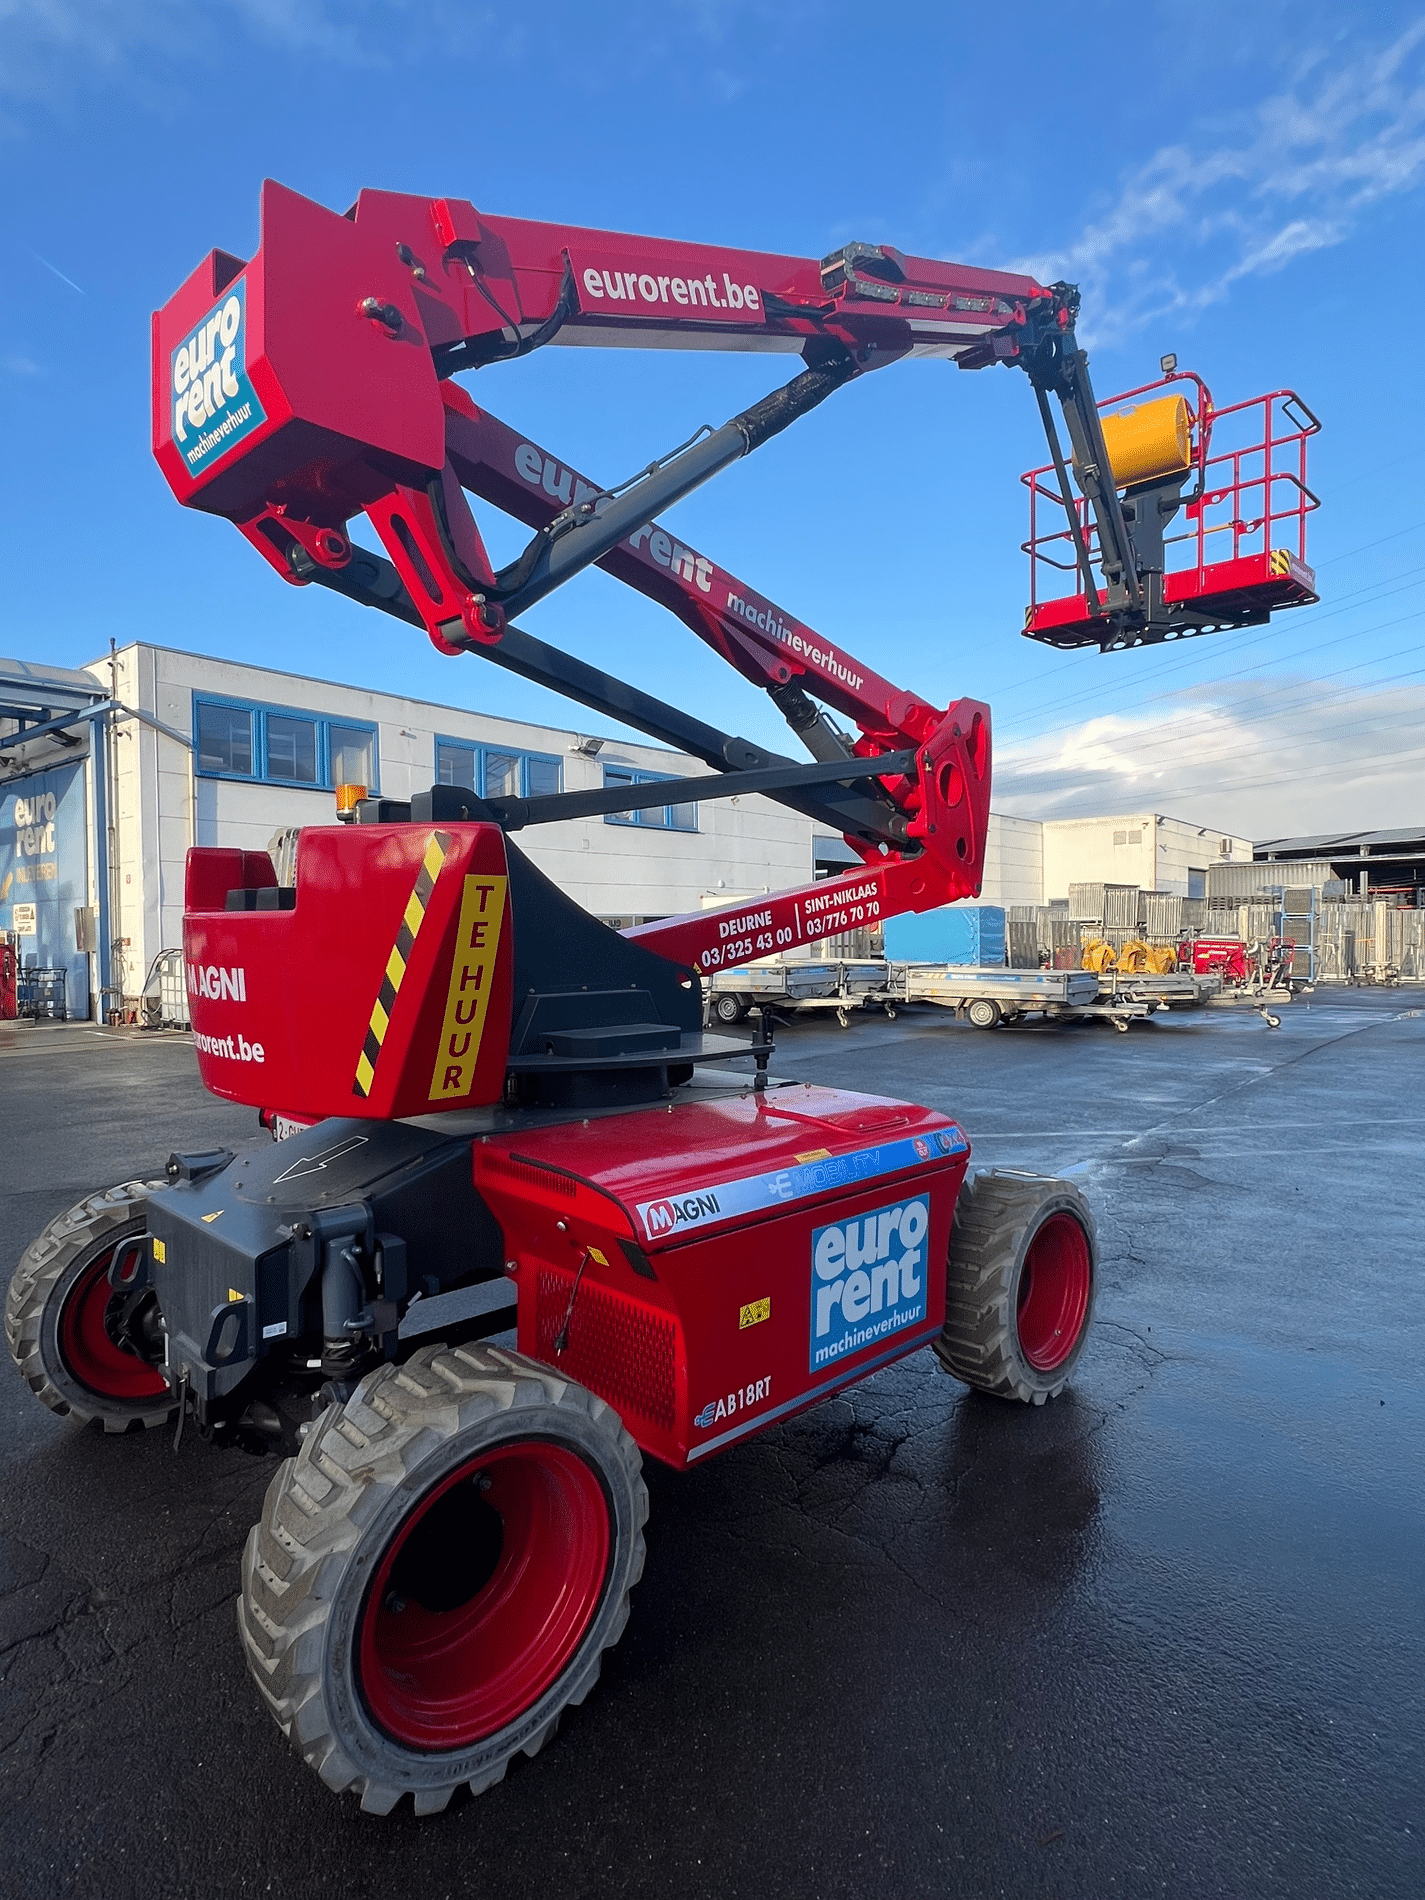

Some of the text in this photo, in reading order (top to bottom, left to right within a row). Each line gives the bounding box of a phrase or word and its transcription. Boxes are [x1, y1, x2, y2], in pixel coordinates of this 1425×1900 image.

[583, 267, 760, 310] eurorent.be
[174, 295, 241, 395] euro
[175, 344, 240, 443] rent
[186, 402, 252, 465] machineverhuur
[727, 591, 864, 690] machineverhuur
[14, 791, 56, 828] euro
[16, 821, 55, 858] rent
[804, 881, 878, 915] SINT-NIKLAAS
[806, 900, 880, 936] 03/776 70 70
[718, 910, 773, 939] DEURNE
[701, 926, 793, 968] 03/325 43 00
[186, 963, 247, 1002] MAGNI
[442, 964, 484, 1091] HUUR
[648, 1193, 721, 1233] MAGNI
[814, 1200, 929, 1281] euro
[815, 1249, 921, 1338] rent
[815, 1304, 922, 1364] machineverhuur
